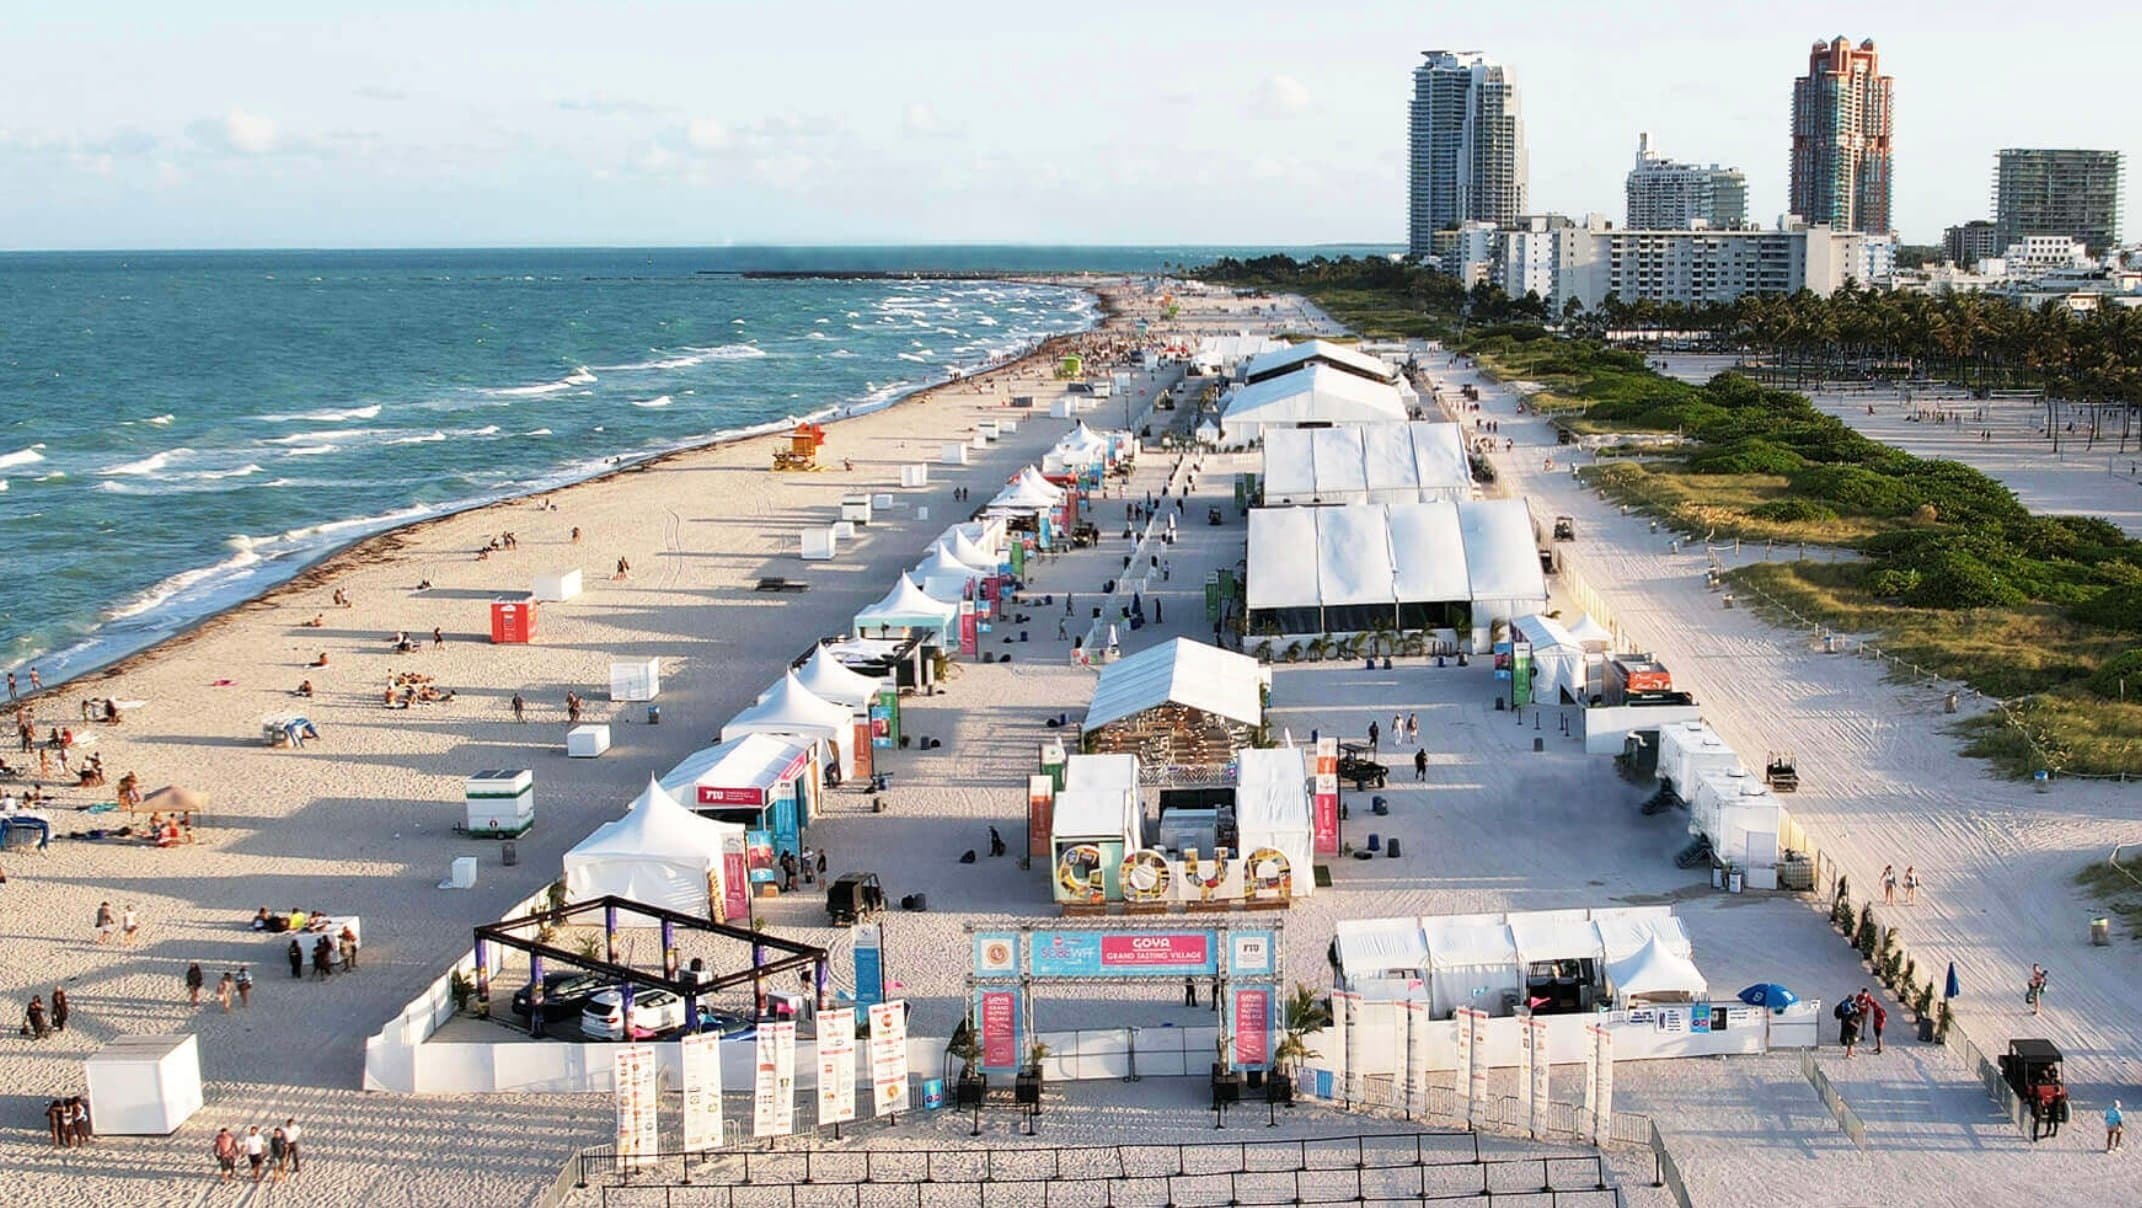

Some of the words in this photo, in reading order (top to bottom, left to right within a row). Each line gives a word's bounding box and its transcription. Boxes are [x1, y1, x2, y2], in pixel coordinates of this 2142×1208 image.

[705, 790, 724, 800] FIU
[1056, 845, 1292, 904] GOYA
[1132, 937, 1171, 949] GOYA
[1243, 943, 1260, 952] FIU
[1106, 952, 1135, 960] GRAND
[1137, 951, 1168, 960] TASTING
[1170, 951, 1202, 959] VILLAGE
